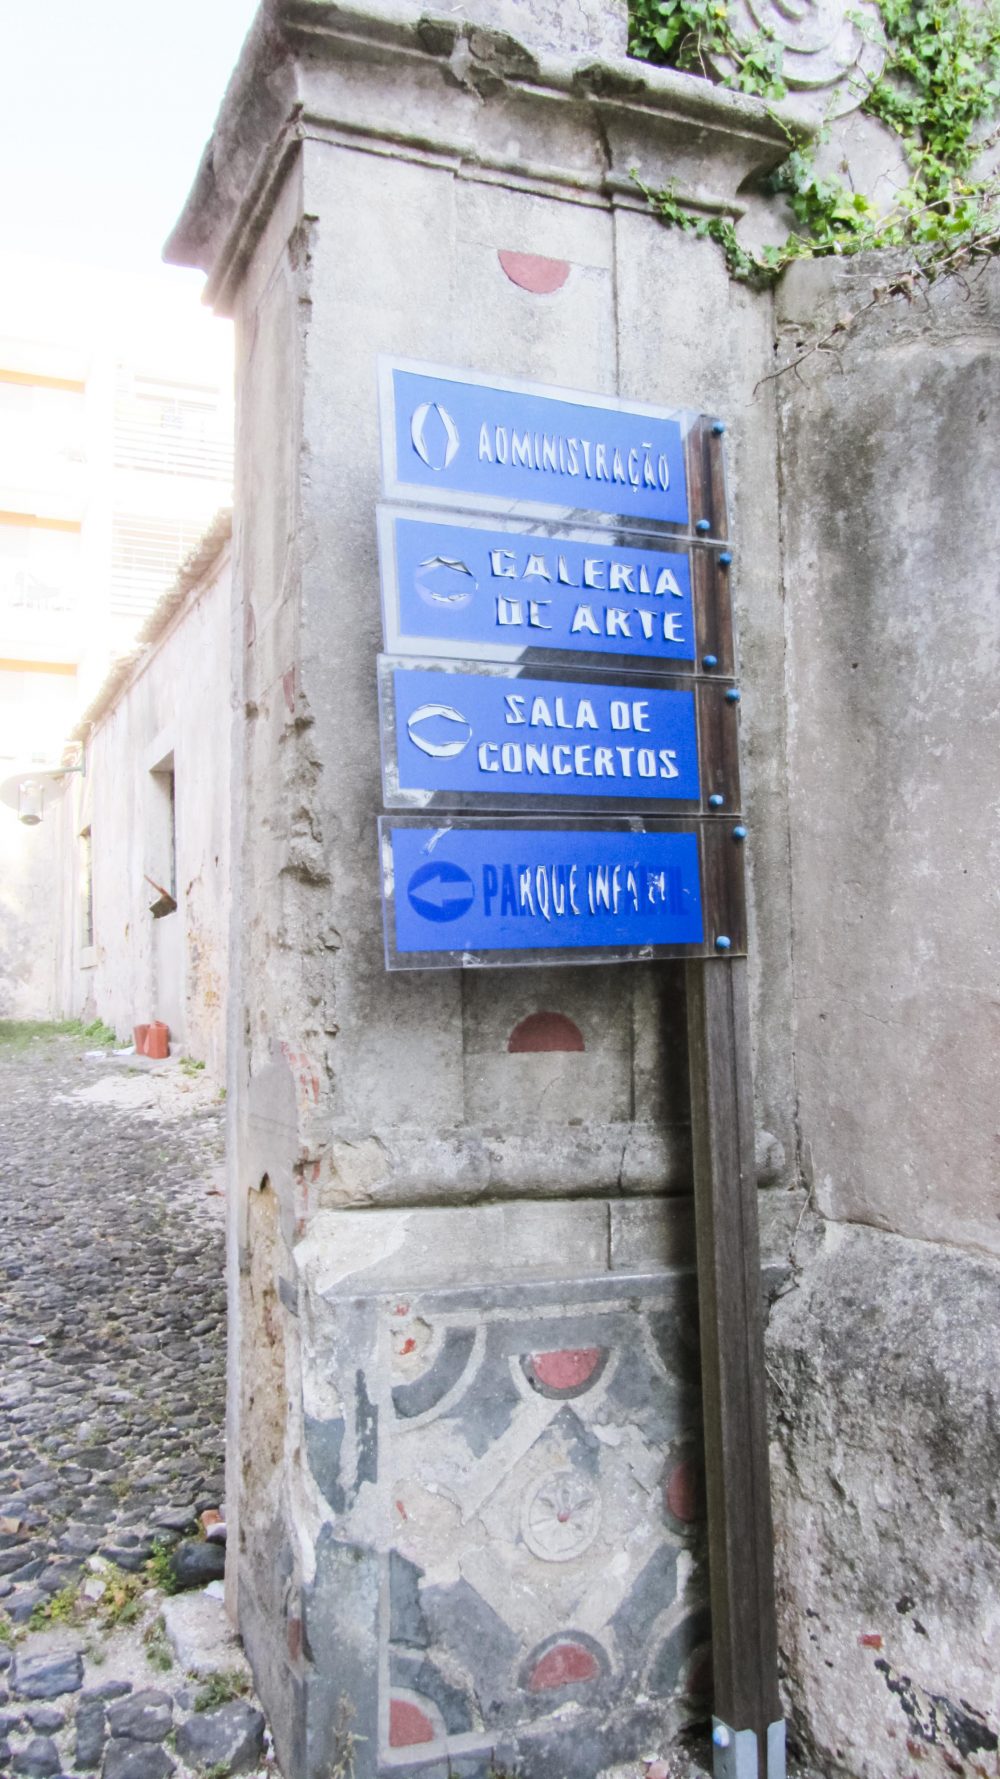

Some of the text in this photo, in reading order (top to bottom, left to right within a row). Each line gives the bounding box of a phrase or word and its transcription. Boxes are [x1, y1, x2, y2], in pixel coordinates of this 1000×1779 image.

[478, 422, 671, 493] ADMINISTRAÇÃO
[489, 549, 684, 598] GALERIA
[571, 603, 686, 642] ARTE
[503, 694, 650, 732] SALA DE
[477, 742, 679, 779] CONCERTOS
